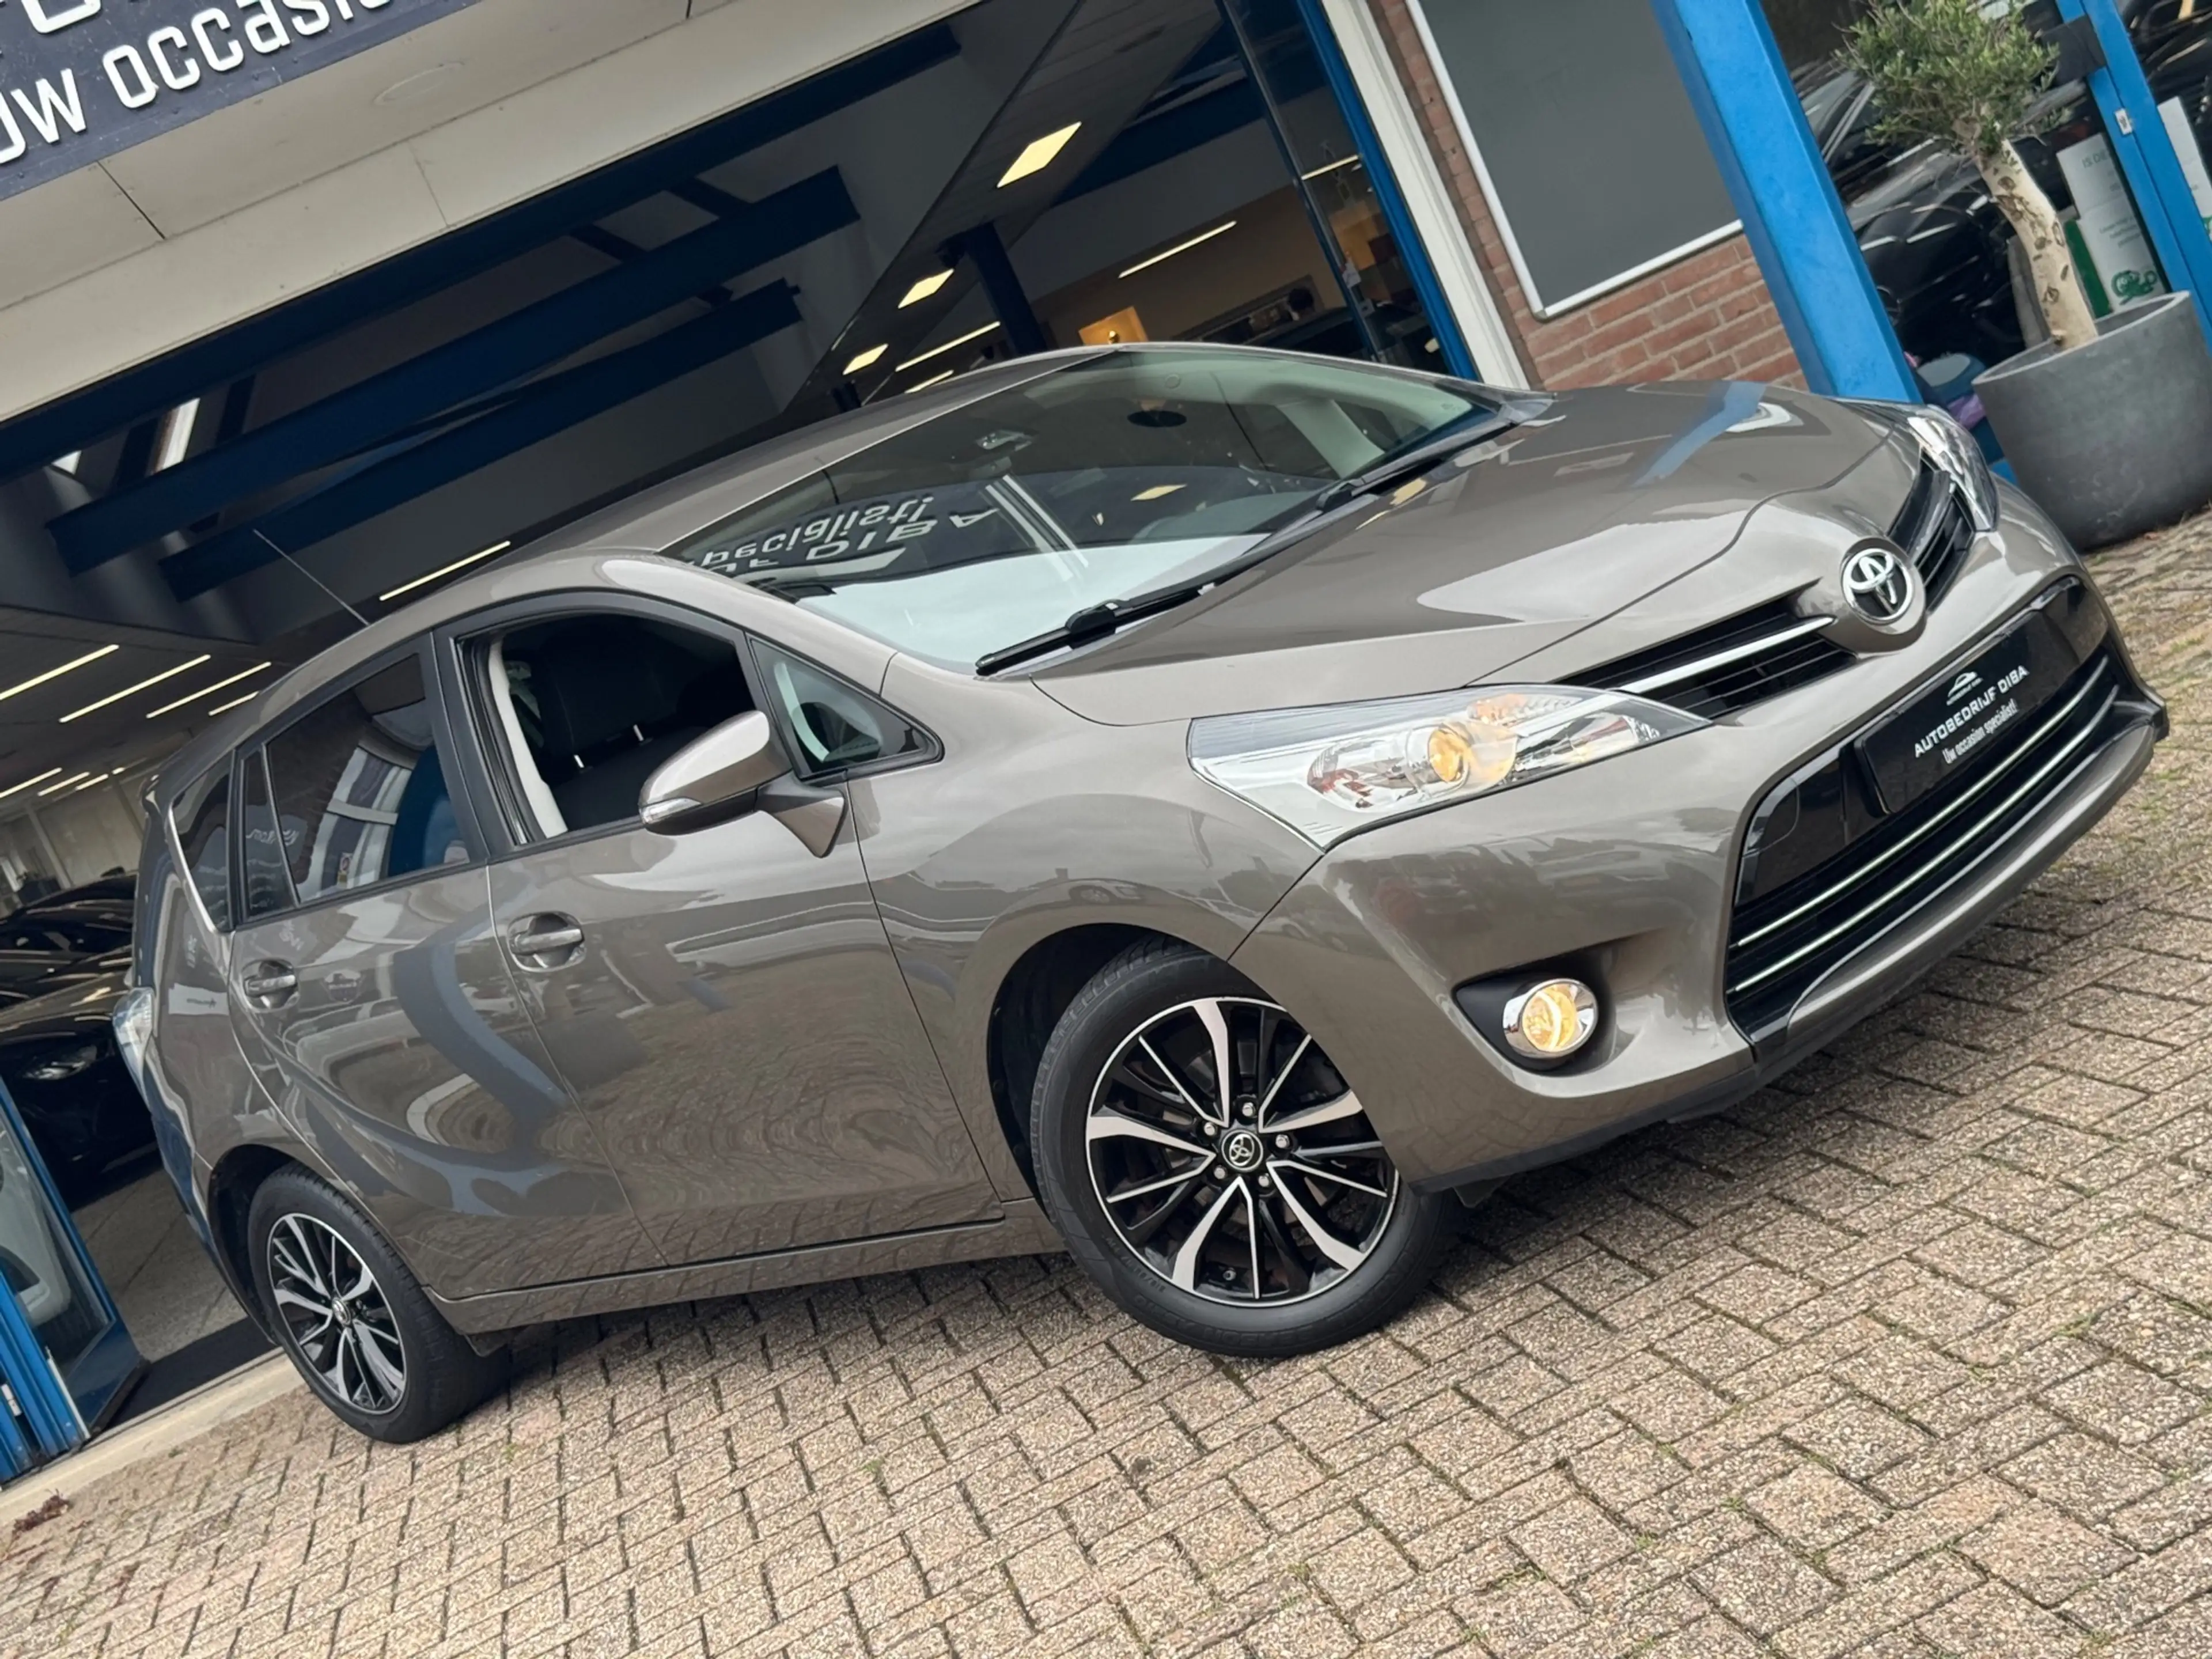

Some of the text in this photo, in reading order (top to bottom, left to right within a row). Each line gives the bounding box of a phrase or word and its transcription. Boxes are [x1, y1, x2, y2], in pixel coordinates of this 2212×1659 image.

[103, 0, 392, 108] occas
[1914, 665, 2030, 758] AUTOBEDRIJF DIBA
[1942, 748, 1957, 764] Uw
[1955, 728, 1986, 756] occasion
